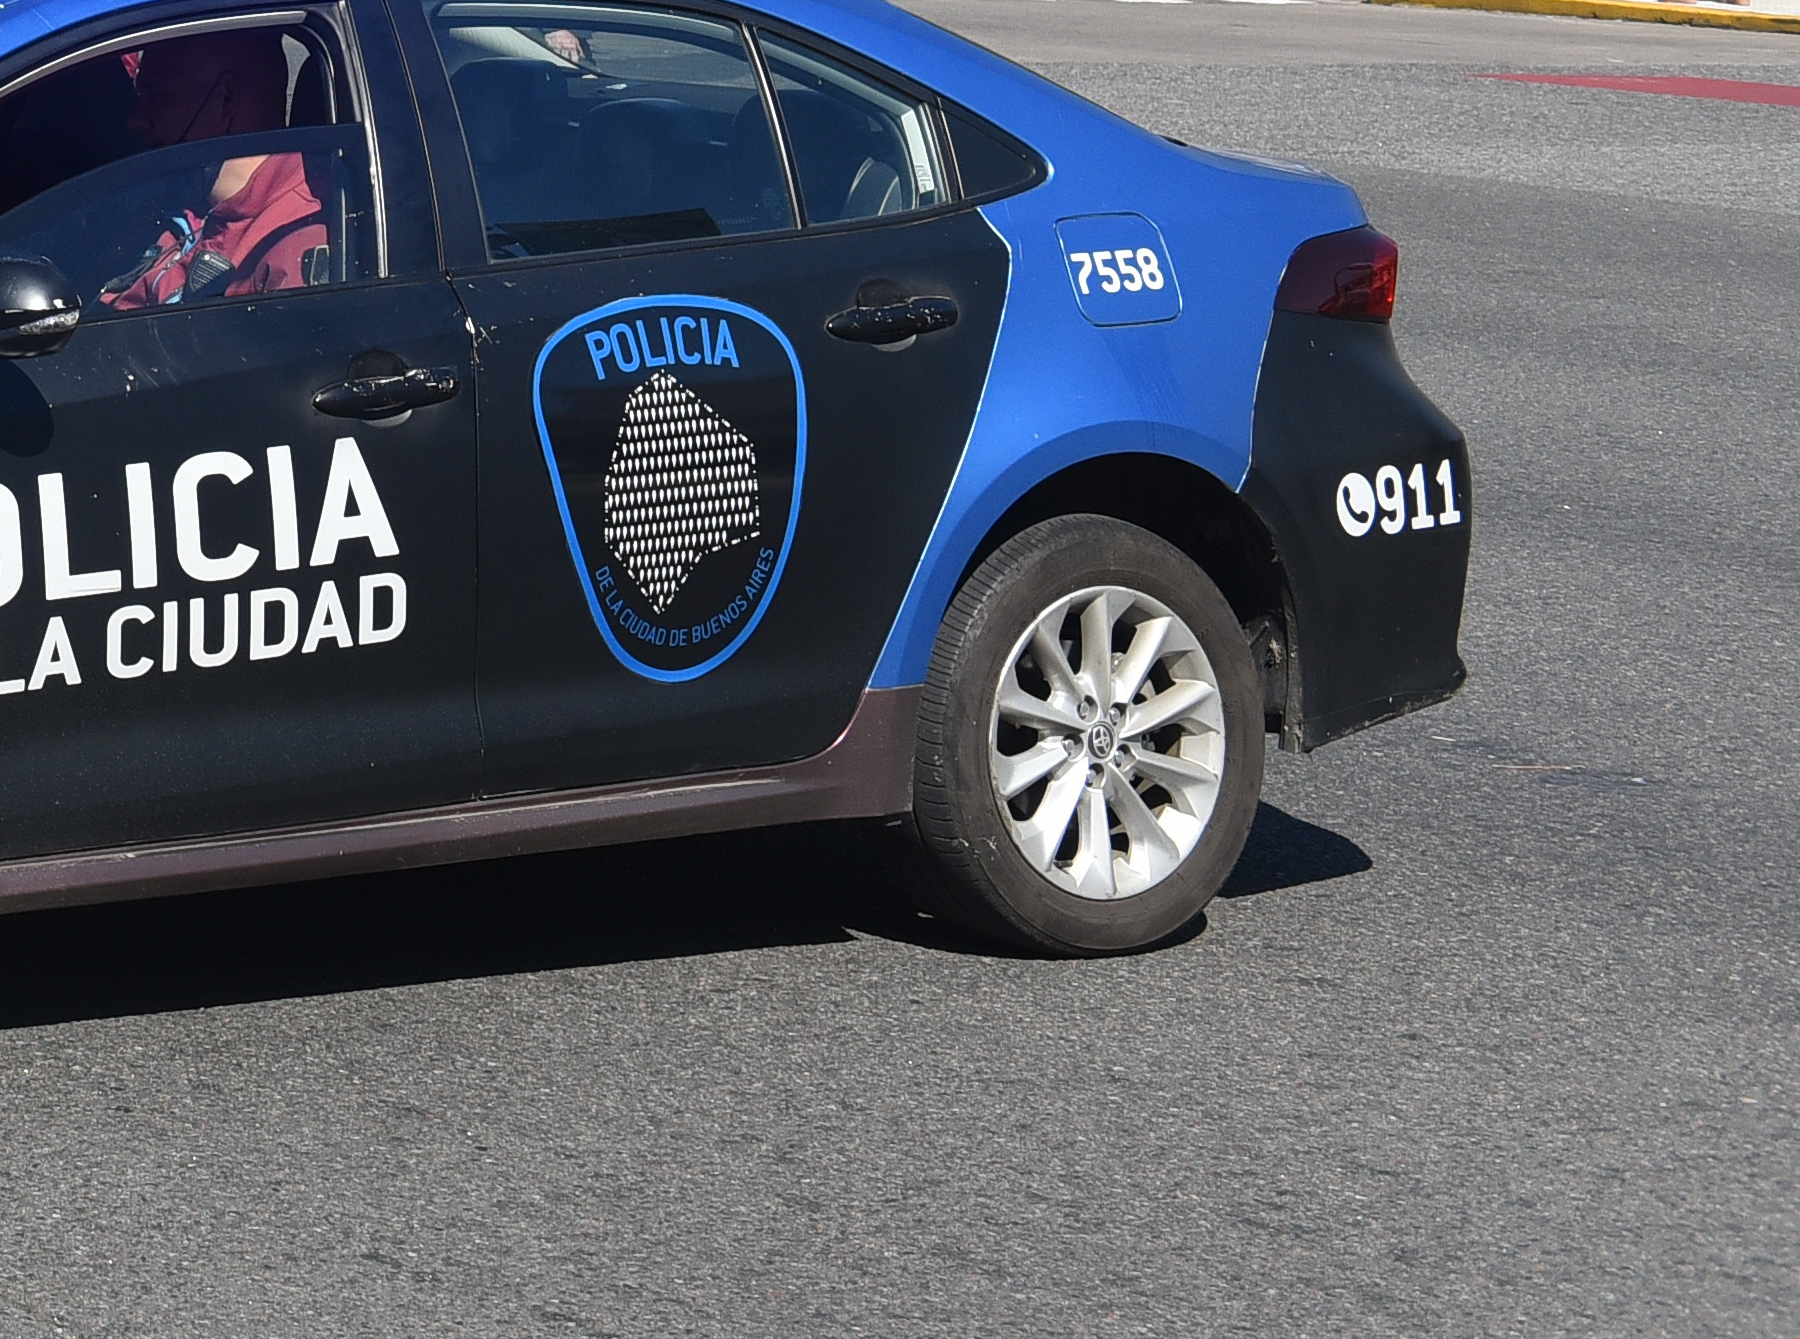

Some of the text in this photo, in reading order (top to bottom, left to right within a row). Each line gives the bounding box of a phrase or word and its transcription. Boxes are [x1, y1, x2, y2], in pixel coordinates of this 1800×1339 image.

[1070, 248, 1164, 294] 7558
[584, 317, 740, 381] POLICIA
[1376, 459, 1461, 535] 911
[106, 572, 407, 679] CIUDAD
[595, 547, 774, 647] DE LA CIUDAD DE BUENOS AIRES
